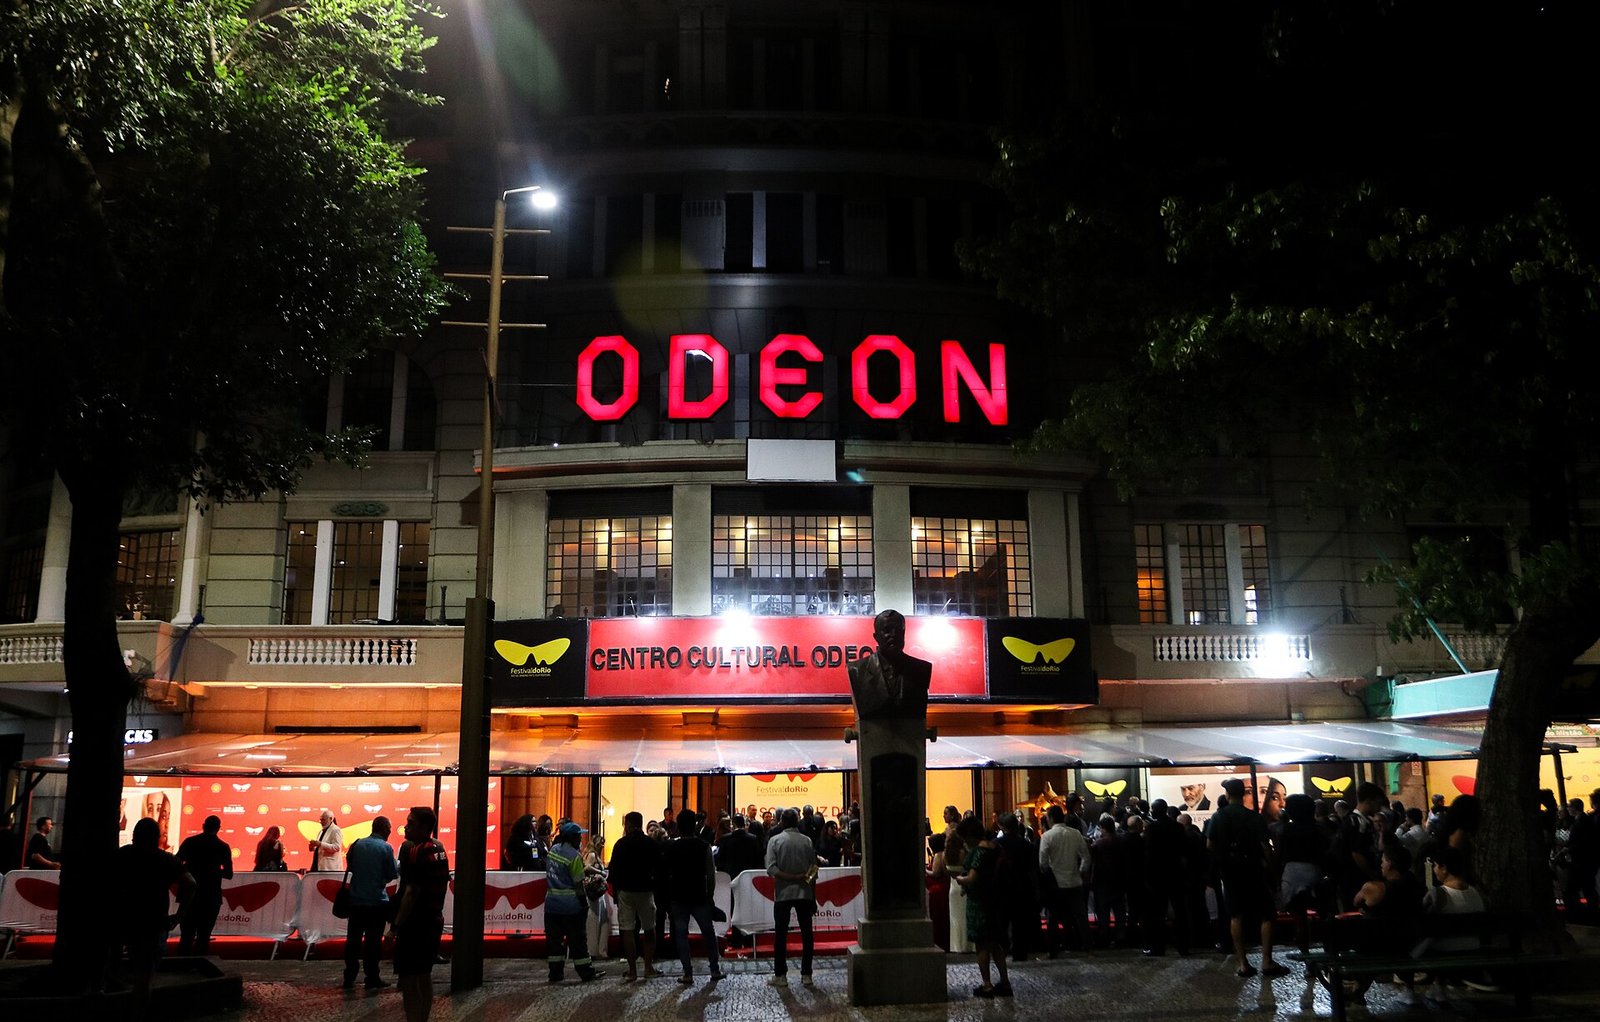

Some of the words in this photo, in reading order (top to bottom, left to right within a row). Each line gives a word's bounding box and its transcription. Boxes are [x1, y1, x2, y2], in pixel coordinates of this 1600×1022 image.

[576, 333, 1009, 426] ODEON
[591, 646, 683, 671] CENTRO
[687, 645, 806, 669] CULTURAL
[812, 645, 880, 668] ODEO
[510, 667, 552, 675] FestivaldoRio
[1020, 665, 1061, 673] FestivaldoRio
[756, 785, 809, 793] FestivaldoRio
